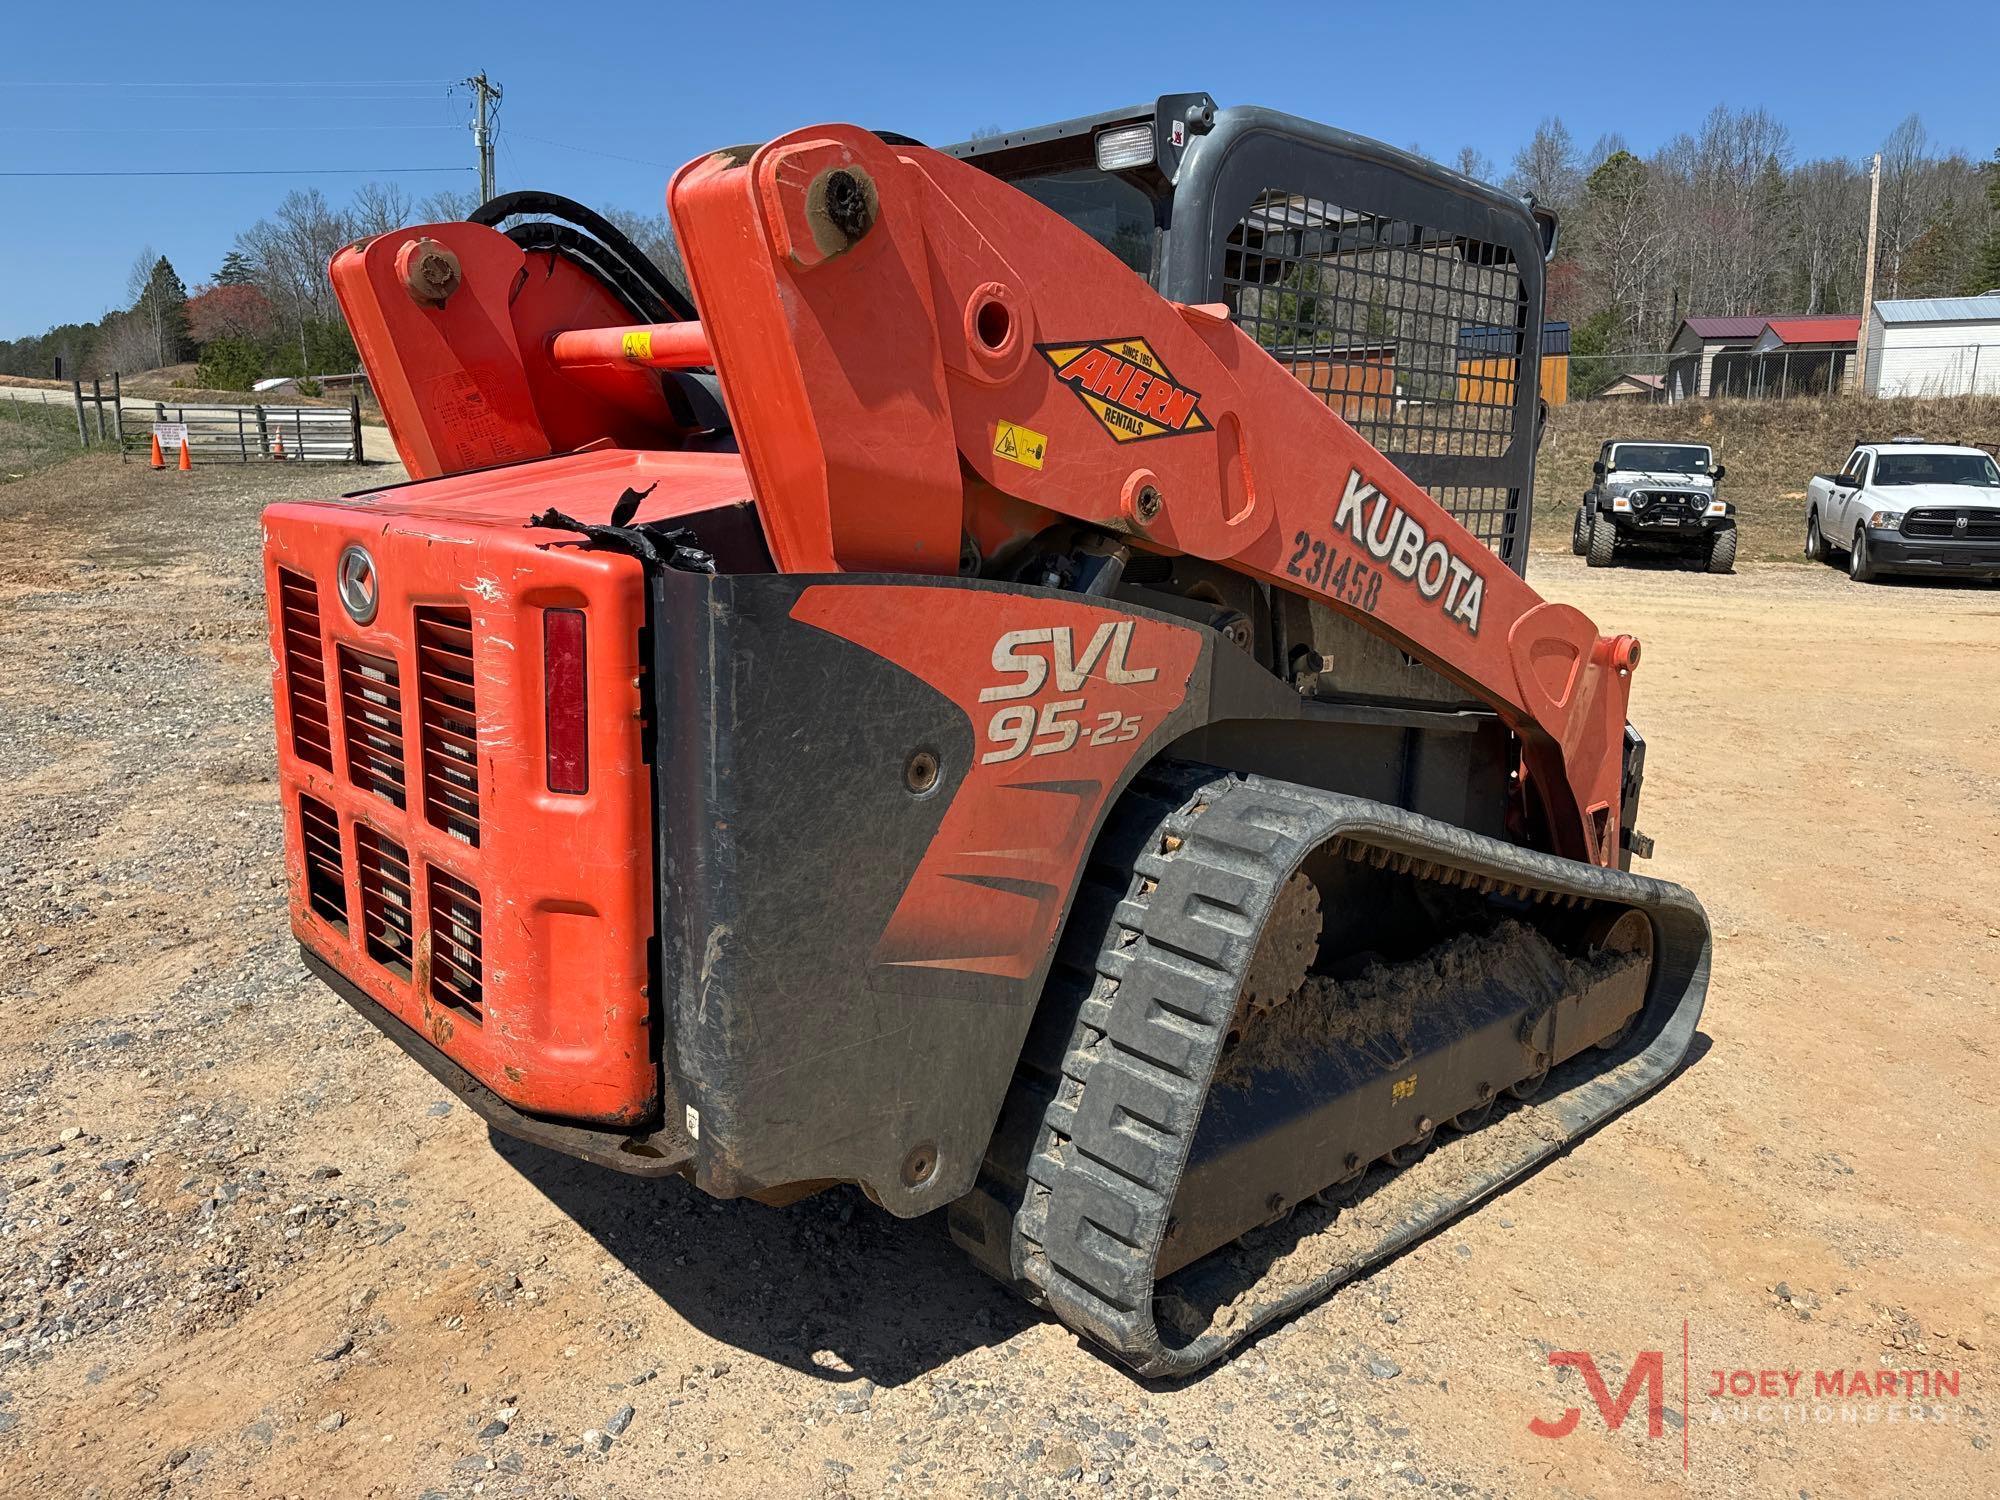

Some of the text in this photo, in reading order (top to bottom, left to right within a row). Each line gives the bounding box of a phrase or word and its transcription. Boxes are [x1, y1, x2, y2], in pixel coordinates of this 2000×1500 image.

[1059, 348, 1197, 430] AHERN
[1122, 344, 1153, 367] SINCE 1953
[1104, 407, 1144, 436] RENTALS
[1287, 530, 1383, 613] 231458
[1333, 468, 1486, 632] KUBOTA
[978, 621, 1159, 703] SVL
